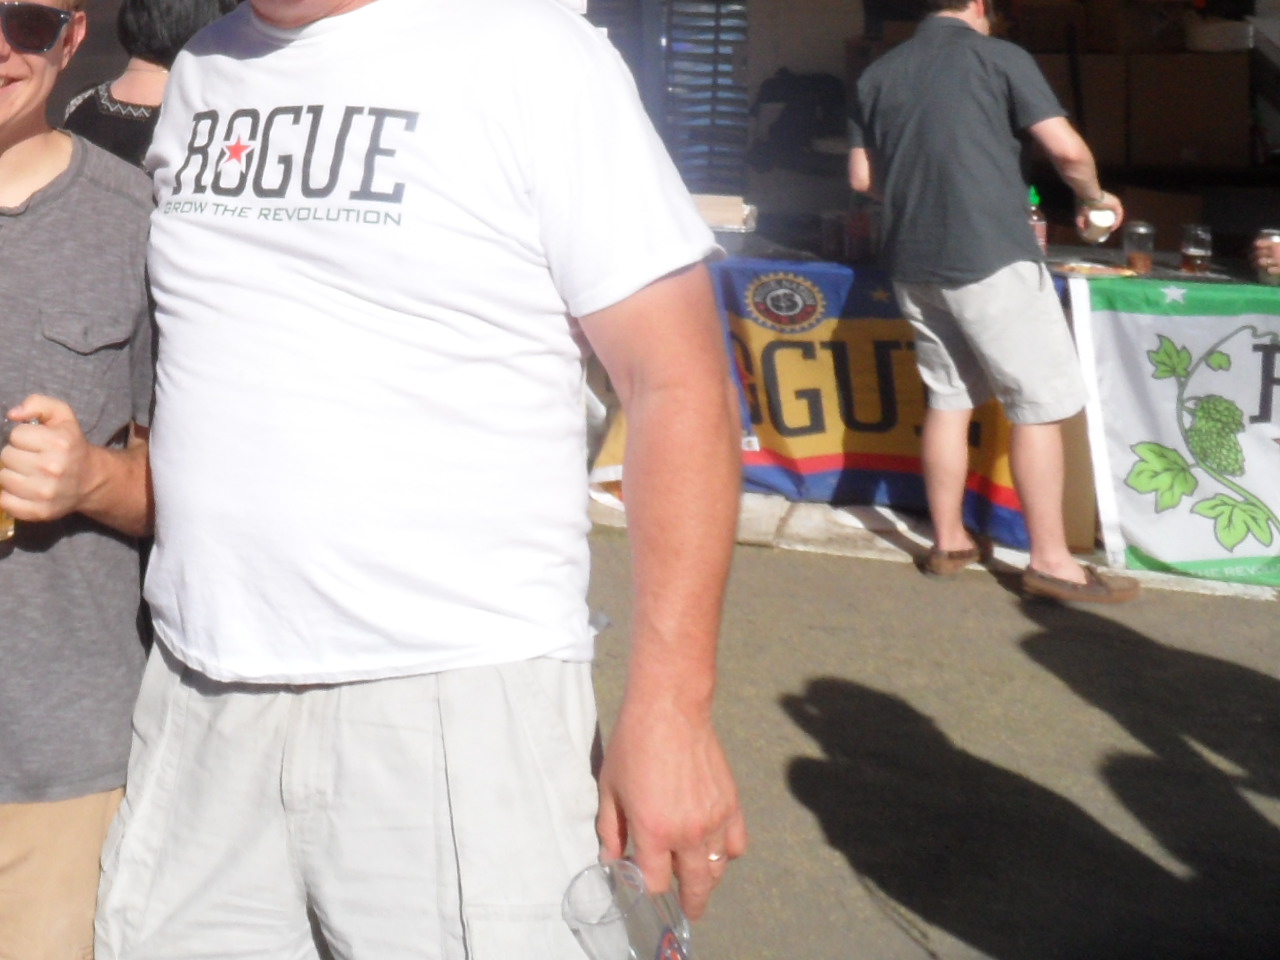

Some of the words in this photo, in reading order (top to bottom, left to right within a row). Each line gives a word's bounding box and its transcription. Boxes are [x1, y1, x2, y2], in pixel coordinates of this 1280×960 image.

[171, 104, 420, 204] ROGUE
[212, 203, 253, 218] THE
[257, 207, 403, 226] REVOLUTION
